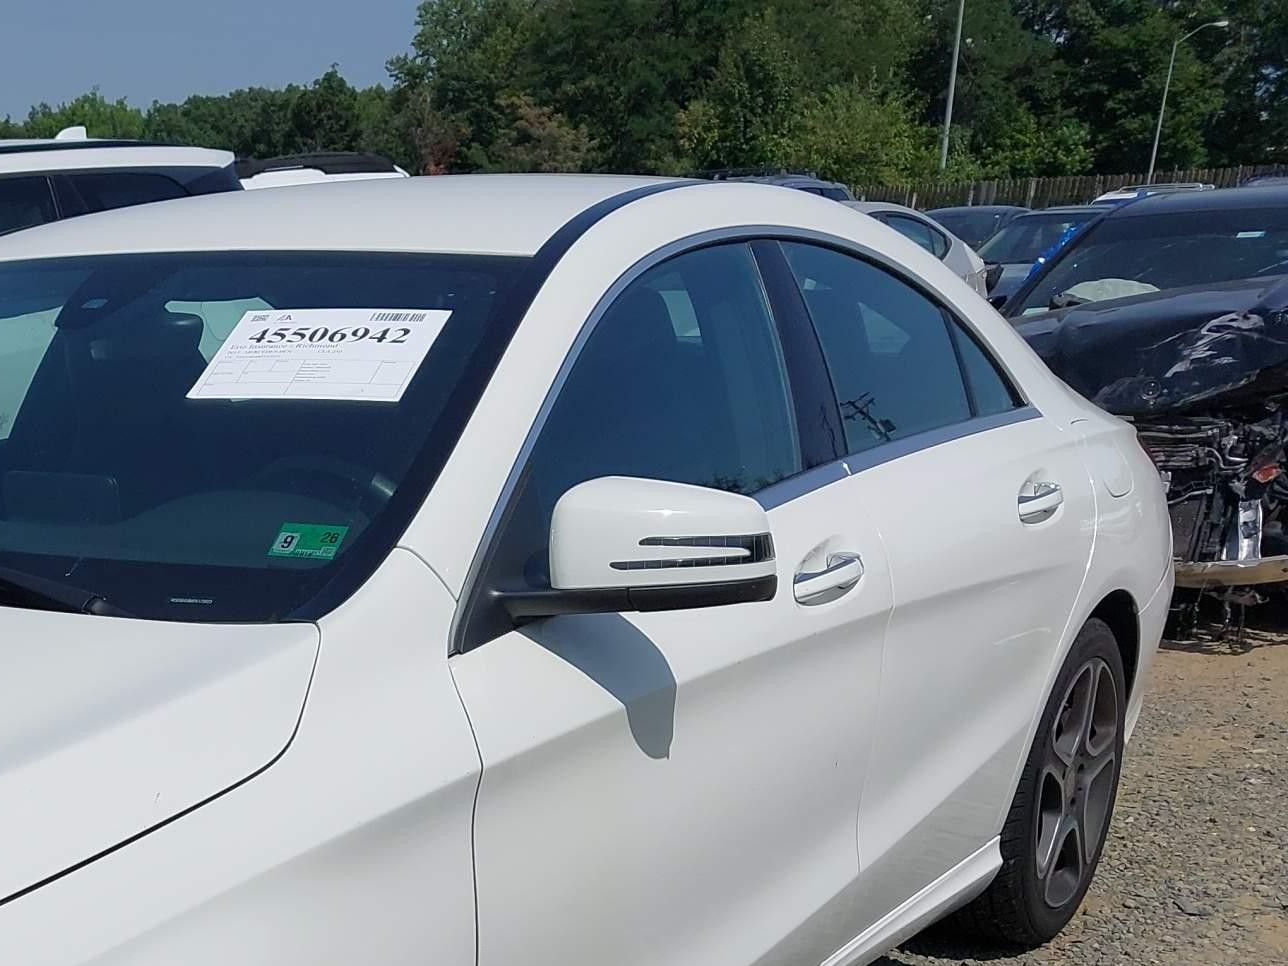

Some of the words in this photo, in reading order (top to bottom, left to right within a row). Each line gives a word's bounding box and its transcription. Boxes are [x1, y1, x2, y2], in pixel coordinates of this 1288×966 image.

[248, 327, 412, 344] 45506942
[281, 535, 295, 549] 9
[320, 532, 340, 544] 26
